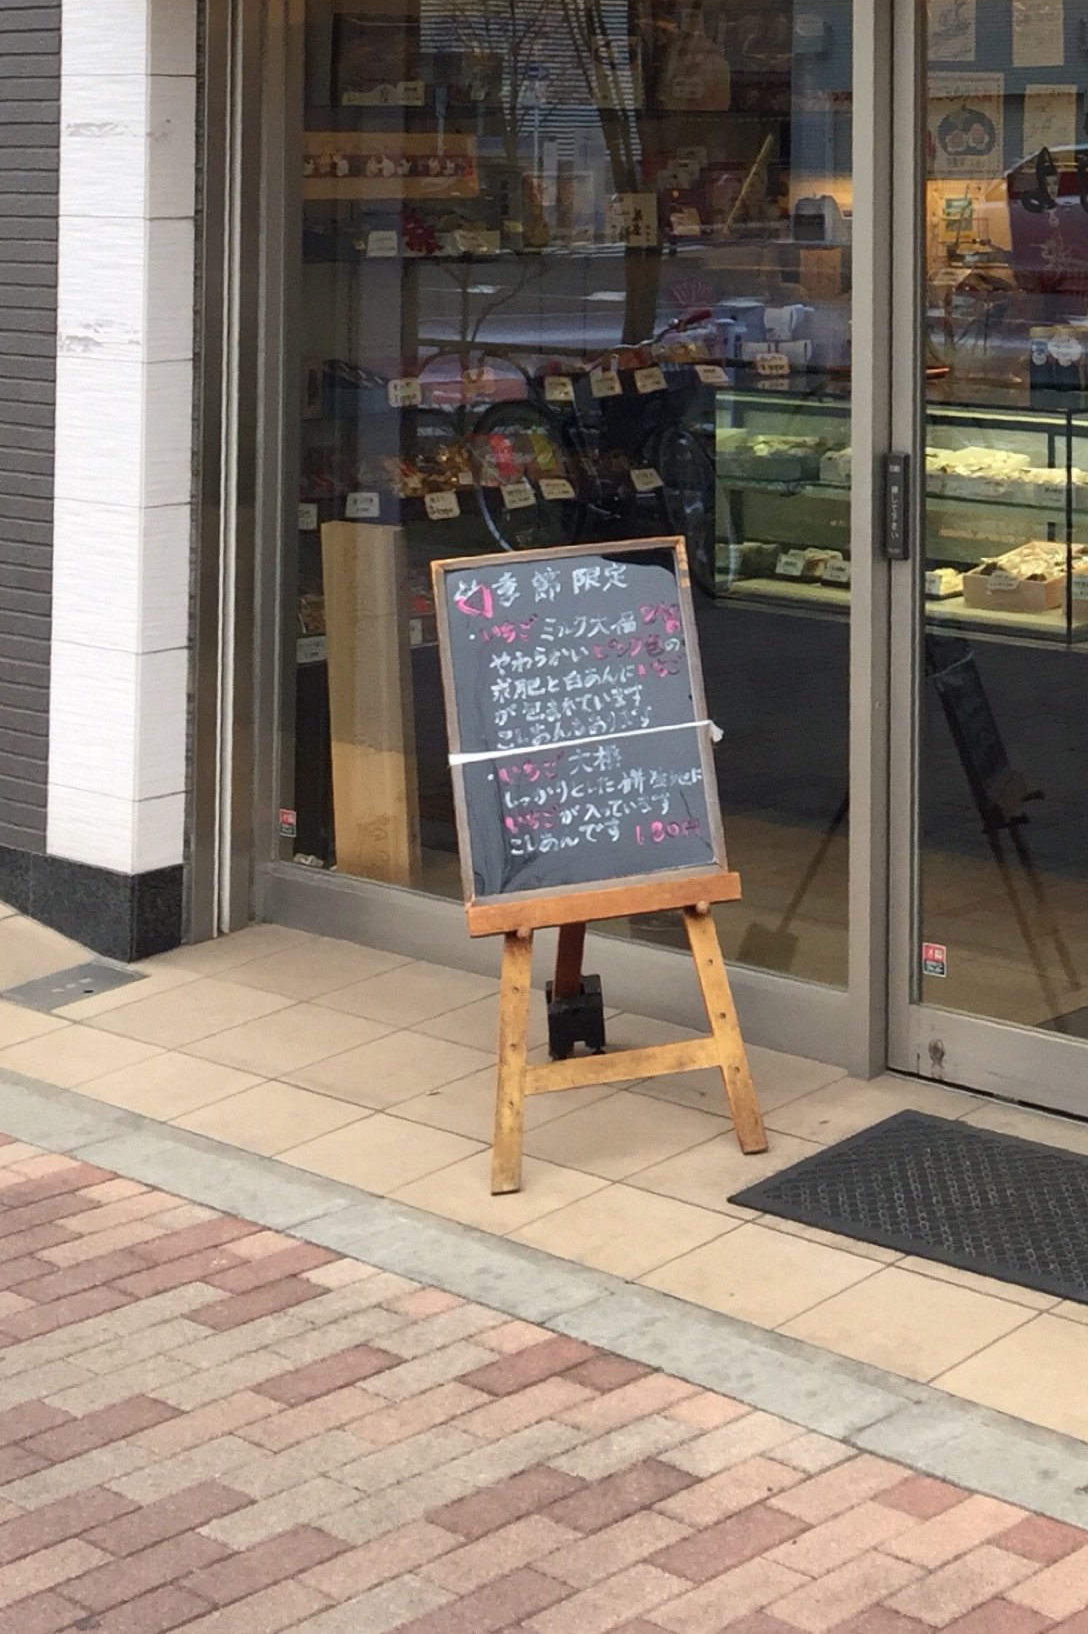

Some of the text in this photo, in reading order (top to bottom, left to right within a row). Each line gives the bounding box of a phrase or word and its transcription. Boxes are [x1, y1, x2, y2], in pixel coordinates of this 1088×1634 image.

[491, 563, 628, 607] 季節限定
[510, 818, 621, 855] こしあんです
